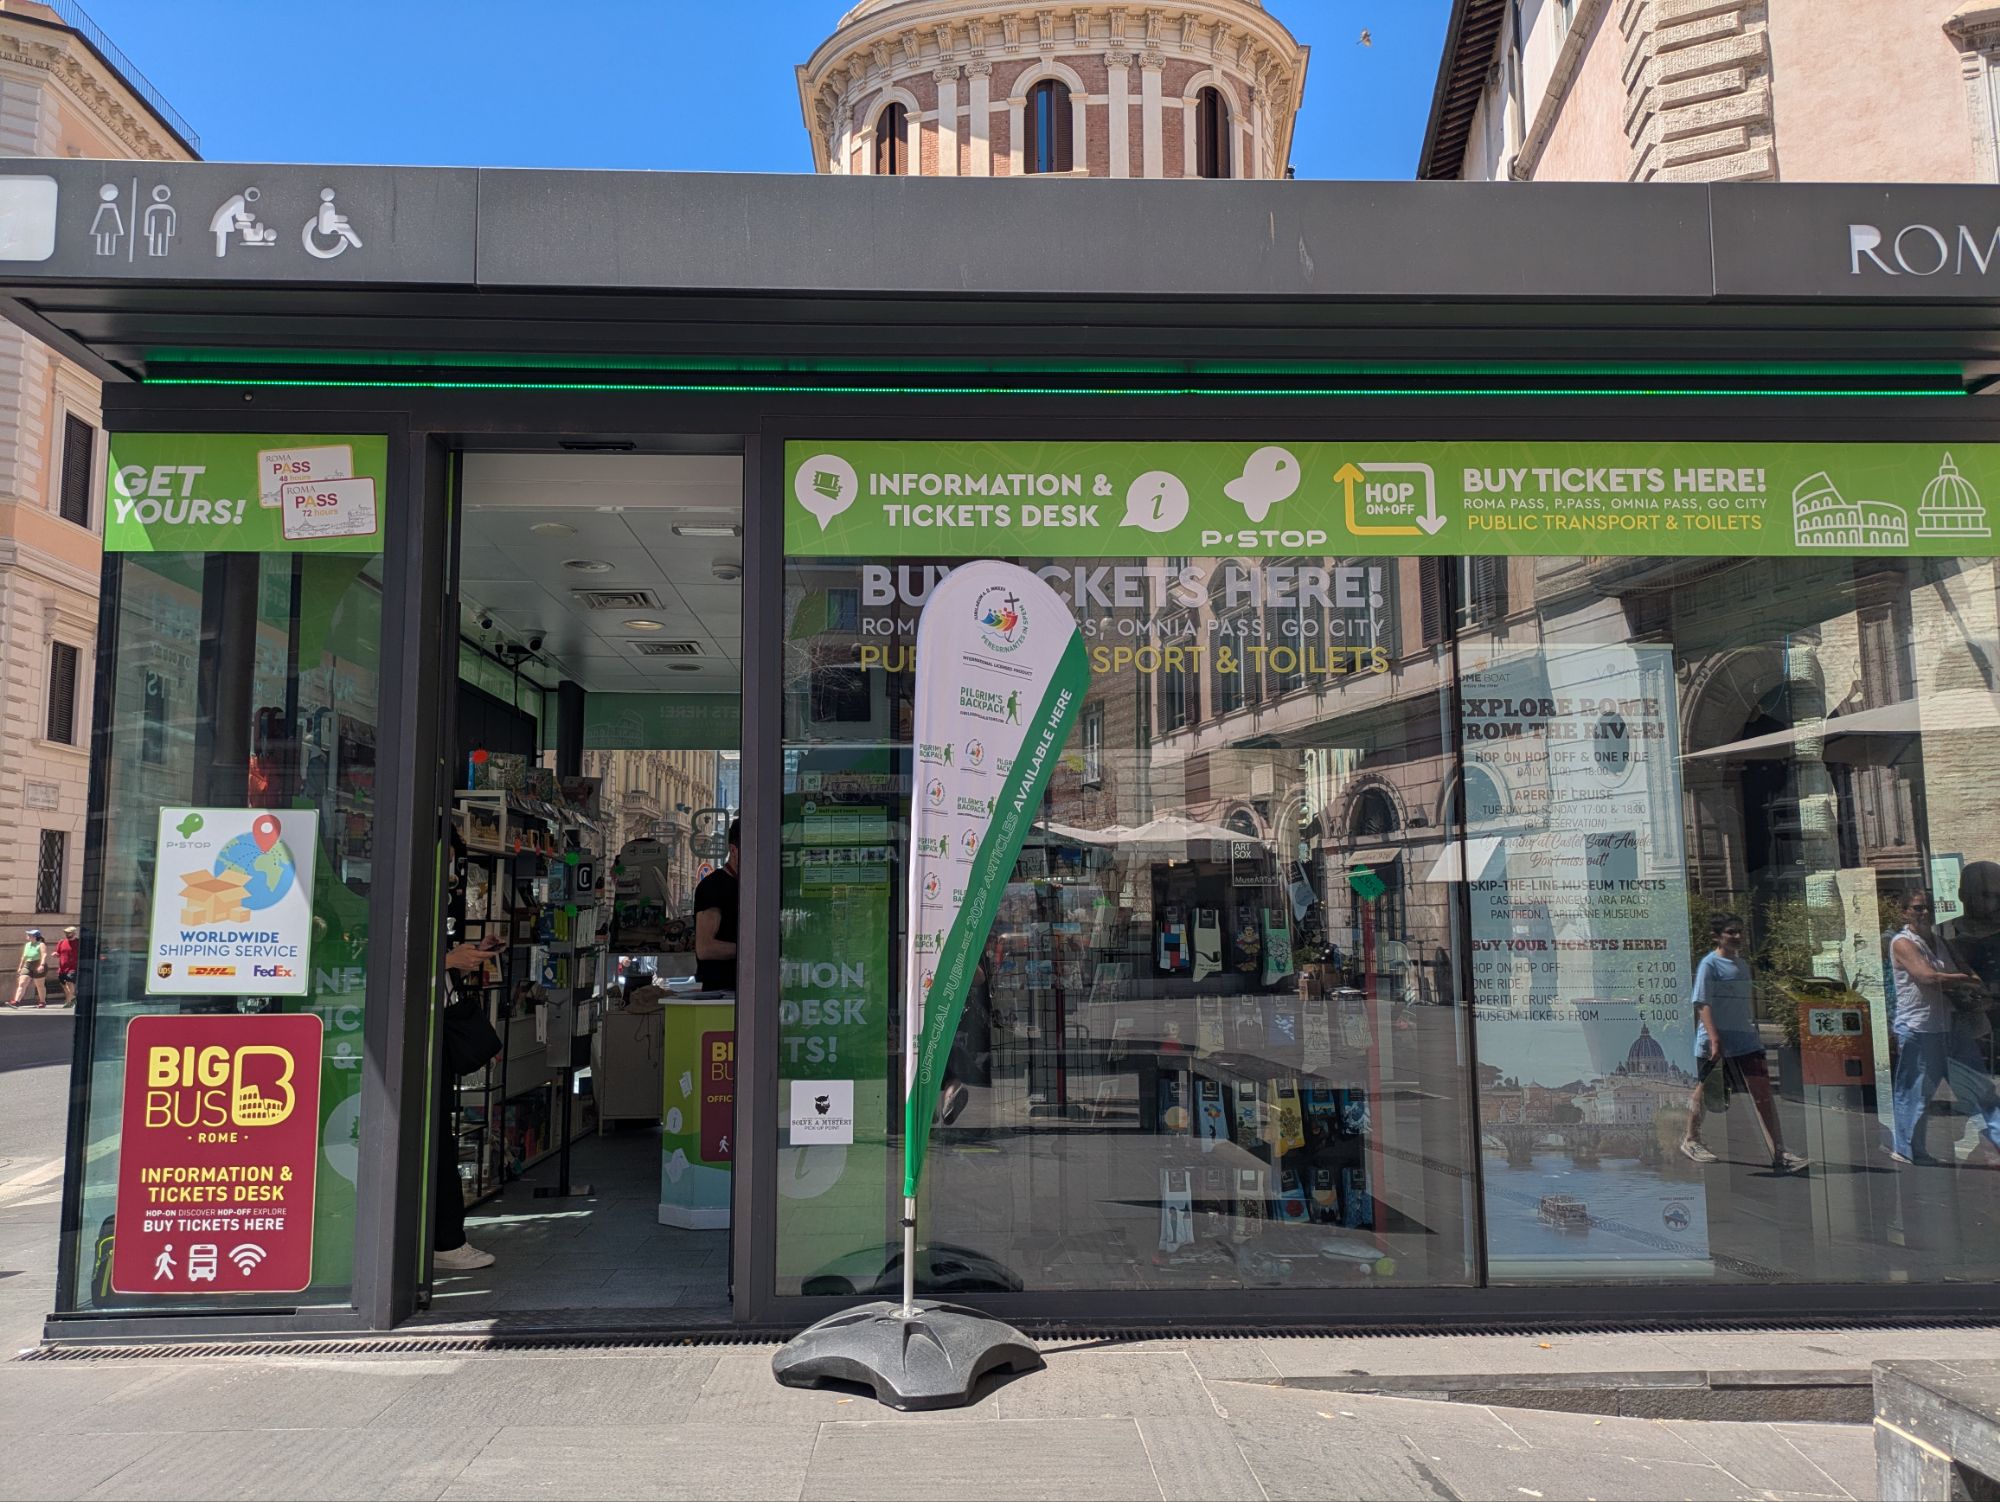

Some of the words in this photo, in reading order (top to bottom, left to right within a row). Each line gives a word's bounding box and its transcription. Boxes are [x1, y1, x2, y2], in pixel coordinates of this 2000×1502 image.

[266, 454, 292, 462] ROMA
[274, 461, 310, 474] PASS
[114, 465, 206, 497] GET
[870, 473, 1082, 496] INFORMATION
[1092, 473, 1112, 496] &
[1464, 468, 1528, 492] BUY
[1532, 468, 1664, 492] TICKETS
[1674, 468, 1766, 492] HERE!
[287, 486, 316, 494] ROMA
[1365, 483, 1414, 504] HOP
[296, 493, 338, 508] PASS
[1464, 498, 1505, 509] ROMA
[1510, 498, 1549, 511] PASS,
[1554, 498, 1605, 511] P.PASS,
[1611, 498, 1658, 509] OMNIA
[1664, 498, 1702, 511] PASS,
[1707, 498, 1729, 509] GO
[1735, 498, 1767, 509] CITY
[113, 498, 247, 525] YOURS!
[883, 504, 1011, 527] TICKETS
[1022, 504, 1099, 527] DESK
[1366, 504, 1414, 515] ON+OFF
[1468, 515, 1538, 530] PUBLIC
[1542, 515, 1660, 530] TRANSPORT
[1666, 515, 1678, 530] &
[1683, 515, 1762, 530] TOILETS
[863, 565, 950, 606] BU
[1036, 566, 1208, 608] CKETS
[1226, 566, 1383, 608] HERE!
[863, 618, 914, 636] ROM
[1117, 619, 1198, 637] OMNIA
[1207, 619, 1271, 640] PASS,
[1282, 619, 1319, 637] GO
[1329, 619, 1384, 637] CITY
[1092, 646, 1206, 674] SPORT
[1216, 648, 1238, 674] &
[1247, 646, 1389, 674] TOILETS
[1484, 673, 1512, 682] BOAT
[960, 686, 1003, 704] PILGRIM'S
[960, 696, 1005, 714] BACKPACK
[1579, 698, 1658, 716] ROME
[1462, 722, 1522, 740] ROM
[1529, 722, 1578, 739] THE
[1584, 722, 1664, 739] RIVER!
[1476, 752, 1500, 762] HOP
[1504, 752, 1520, 762] ON
[1526, 752, 1550, 762] HOP
[1554, 752, 1576, 762] OFF
[1580, 752, 1589, 762] &
[1594, 752, 1618, 762] ONE
[1622, 752, 1648, 762] RIDE
[1518, 767, 1542, 776] DAILY
[1585, 766, 1608, 776] 18:00
[984, 812, 1020, 889] ARTICLES
[1014, 728, 1055, 812] AVAILABLE
[1048, 688, 1072, 728] HERE
[1515, 790, 1567, 800] APERITIF
[1572, 789, 1614, 800] CRUISE
[1483, 805, 1522, 814] TUESDAY
[1542, 804, 1577, 814] SUNDAY
[1582, 804, 1607, 814] 17:00
[1610, 804, 1618, 814] &
[1543, 819, 1607, 829] RESERVATION)
[1586, 852, 1610, 867] out!
[1471, 880, 1559, 891] SKIP-THE-LINE
[1562, 880, 1614, 890] MUSEUM
[1619, 880, 1666, 890] TICKETS
[1490, 896, 1525, 905] CASTEL
[1598, 895, 1617, 905] ARA
[1491, 910, 1544, 920] PANTHEON,
[1604, 909, 1649, 919] MUSEUMS
[180, 930, 280, 943] WORLDWIDE
[159, 944, 230, 957] SHIPPING
[235, 945, 298, 957] SERVICE
[1472, 940, 1501, 951] BUY
[1505, 940, 1548, 951] YOUR
[1552, 940, 1619, 950] TICKETS
[1622, 939, 1668, 950] HERE!
[254, 965, 293, 977] FedEx
[1473, 963, 1492, 973] HOP
[1497, 963, 1512, 973] ON
[1515, 963, 1537, 973] HOP
[1637, 962, 1644, 972] €
[1647, 962, 1676, 973] 21,00
[1638, 978, 1644, 988] €
[1648, 978, 1677, 989] 17,00
[1474, 995, 1518, 1005] APERITIF
[1639, 994, 1645, 1004] €
[1649, 994, 1678, 1005] 45,00
[1472, 1010, 1519, 1021] MUSEUM
[1523, 1010, 1564, 1020] TICKETS
[1568, 1010, 1599, 1020] FROM
[1640, 1010, 1646, 1020] €
[1650, 1010, 1679, 1021] 10,00
[1816, 1018, 1834, 1032] 1€
[712, 1042, 734, 1061] BI
[148, 1046, 230, 1088] BIG
[712, 1062, 734, 1080] BU
[145, 1090, 228, 1128] BUS
[198, 1132, 238, 1143] ROME
[141, 1166, 274, 1184] INFORMATION
[280, 1165, 293, 1181] &
[148, 1186, 228, 1203] TICKETS
[234, 1185, 284, 1201] DESK
[217, 1208, 252, 1216] HOP-OFF
[143, 1220, 173, 1232] BUY
[178, 1218, 240, 1231] TICKETS
[244, 1218, 285, 1230] HERE
